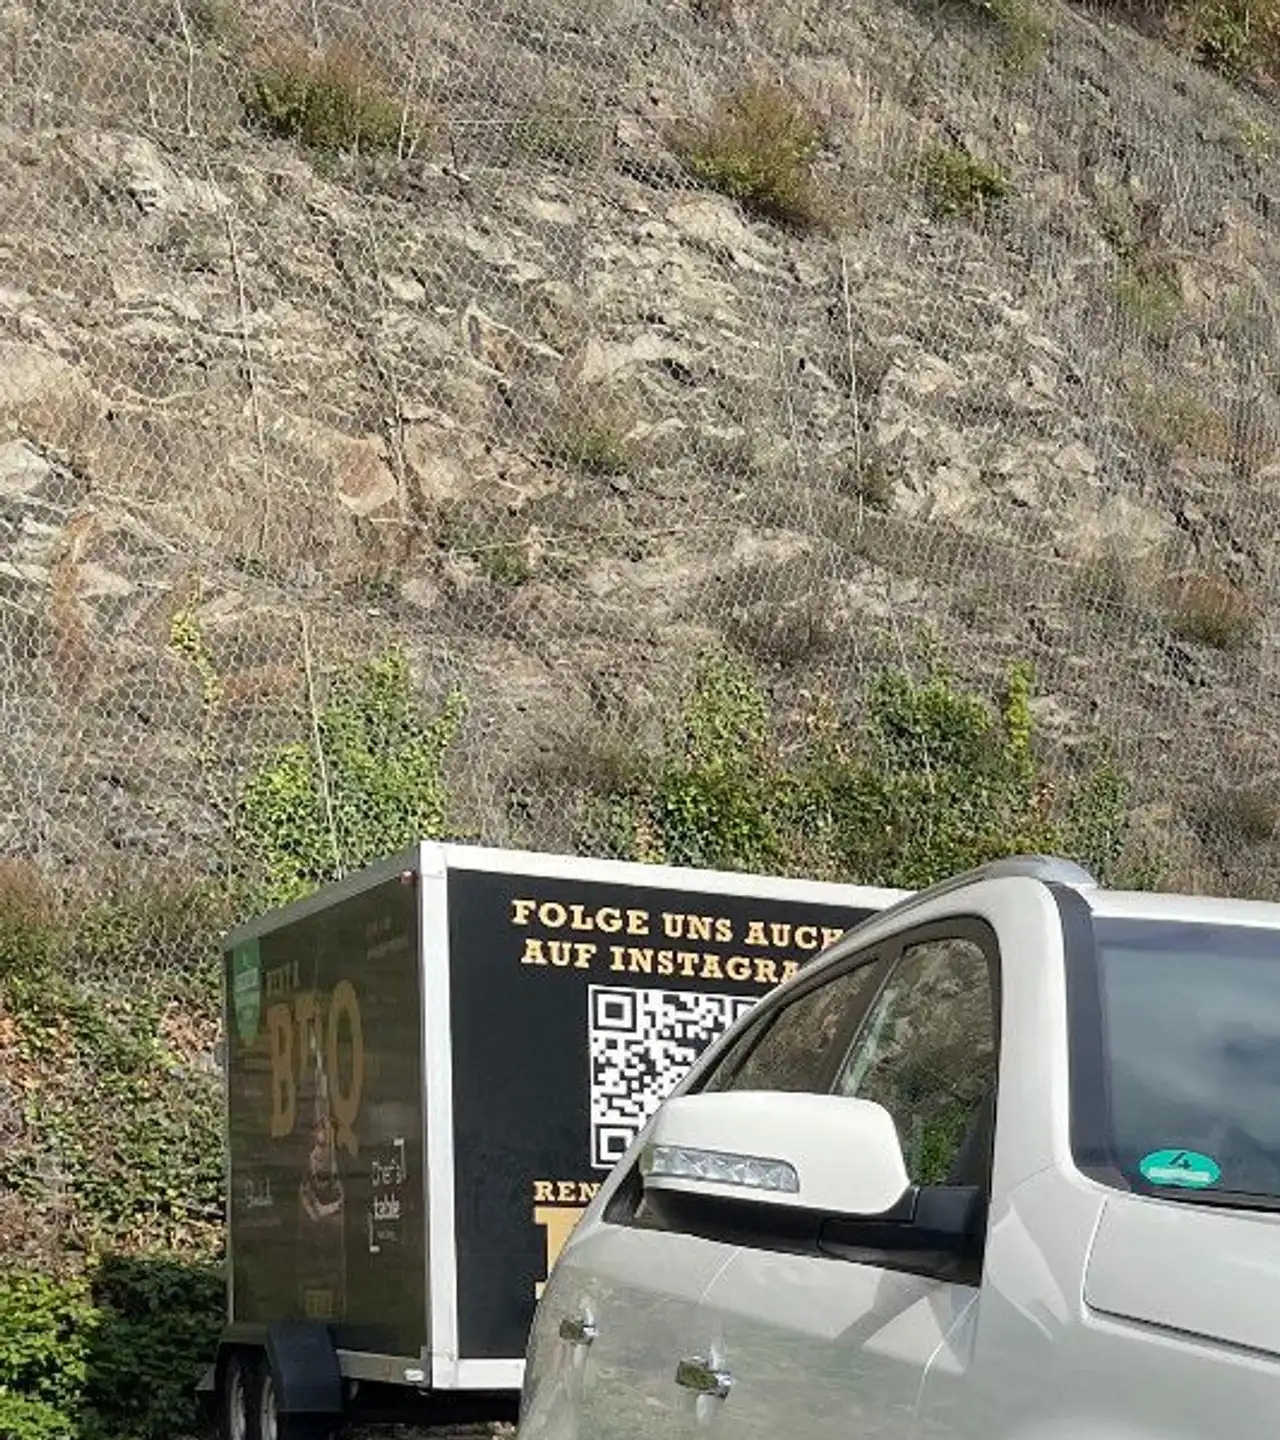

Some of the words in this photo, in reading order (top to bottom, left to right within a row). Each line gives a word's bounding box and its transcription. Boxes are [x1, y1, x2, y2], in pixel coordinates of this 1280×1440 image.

[511, 898, 650, 936] FOLGE
[662, 911, 734, 943] UNS
[520, 937, 598, 969] AUF
[609, 944, 804, 986] INSTAGRA
[1167, 1151, 1193, 1171] 4
